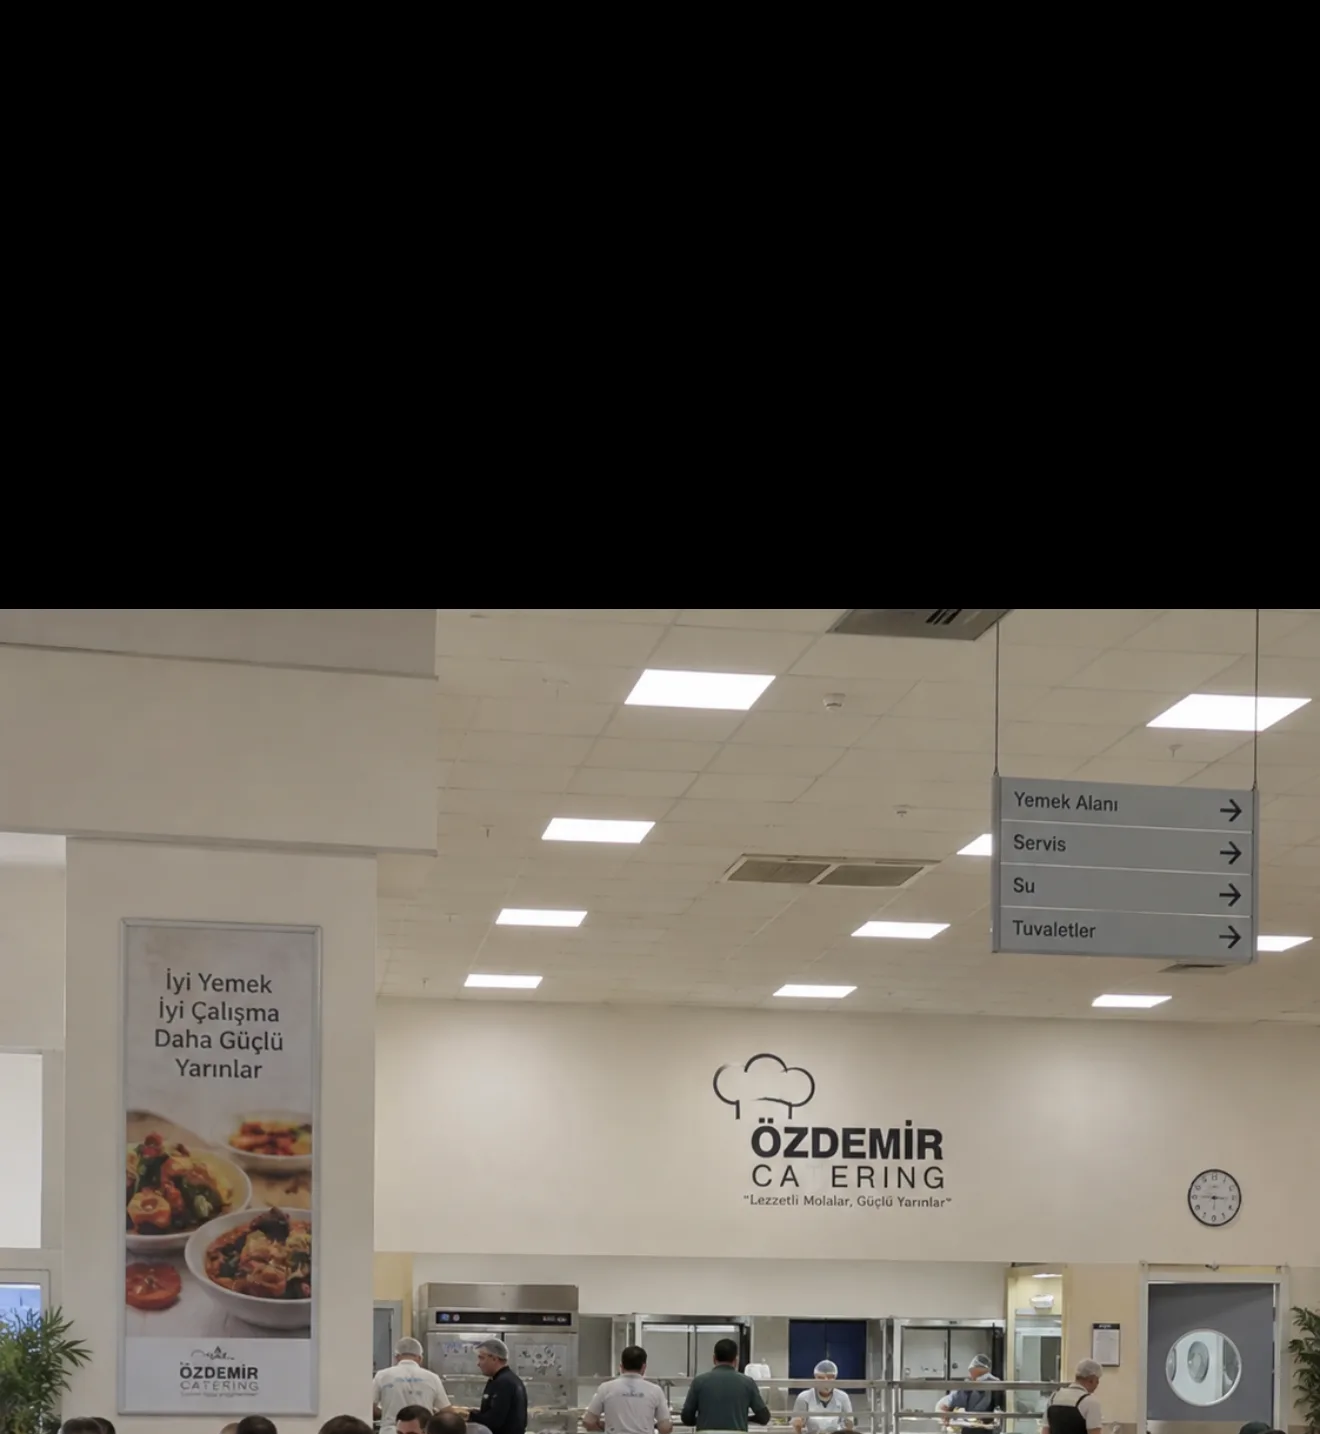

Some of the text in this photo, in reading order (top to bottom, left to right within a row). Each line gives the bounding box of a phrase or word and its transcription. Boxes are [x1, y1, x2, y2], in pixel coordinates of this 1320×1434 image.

[1014, 791, 1118, 811] Yemek Alanı
[1013, 834, 1066, 851] Servis
[1013, 877, 1035, 893] Su
[1012, 920, 1096, 938] Tuvaletler
[166, 968, 272, 995] İyi Yemek
[159, 996, 279, 1026] İyi Çalışma
[155, 1029, 283, 1055] Daha Güçlü
[175, 1058, 263, 1079] Yarınlar
[751, 1117, 943, 1160] ÖZDEMİR
[752, 1164, 944, 1189] CAERING
[803, 1195, 853, 1208] Molalar,
[857, 1195, 893, 1210] Güçlü
[180, 1361, 259, 1380] ÖZDEMİR
[180, 1380, 259, 1392] CATERING
